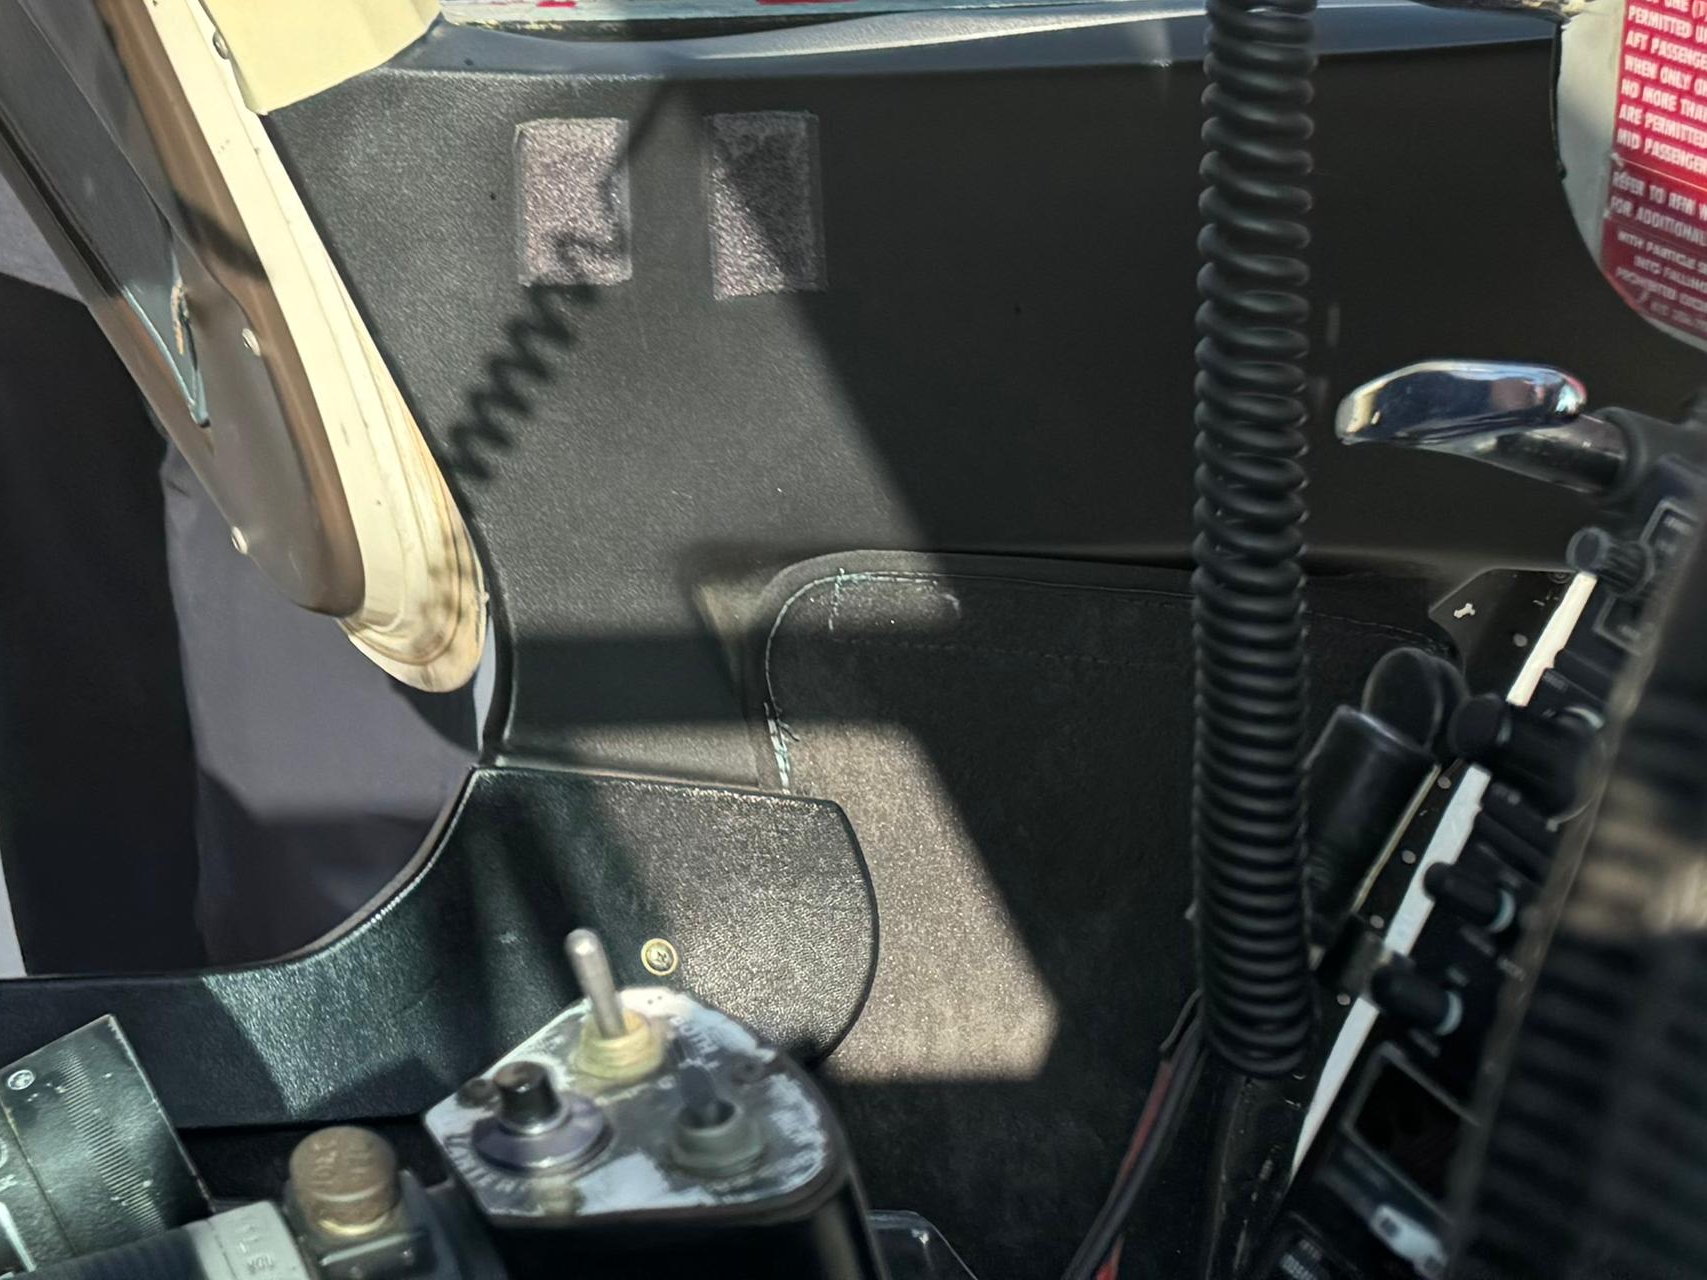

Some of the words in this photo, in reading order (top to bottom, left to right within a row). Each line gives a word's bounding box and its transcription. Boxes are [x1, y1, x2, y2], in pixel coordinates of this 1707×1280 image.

[1628, 4, 1693, 39] PERMITTED
[1625, 30, 1649, 51] AFT
[1624, 54, 1658, 80] WHEN
[1660, 66, 1693, 91] ONLY
[1621, 78, 1640, 99] NO
[1642, 85, 1678, 112] MORE
[1618, 103, 1643, 126] ARE
[1649, 184, 1666, 205] TO
[1610, 195, 1634, 219] FOR
